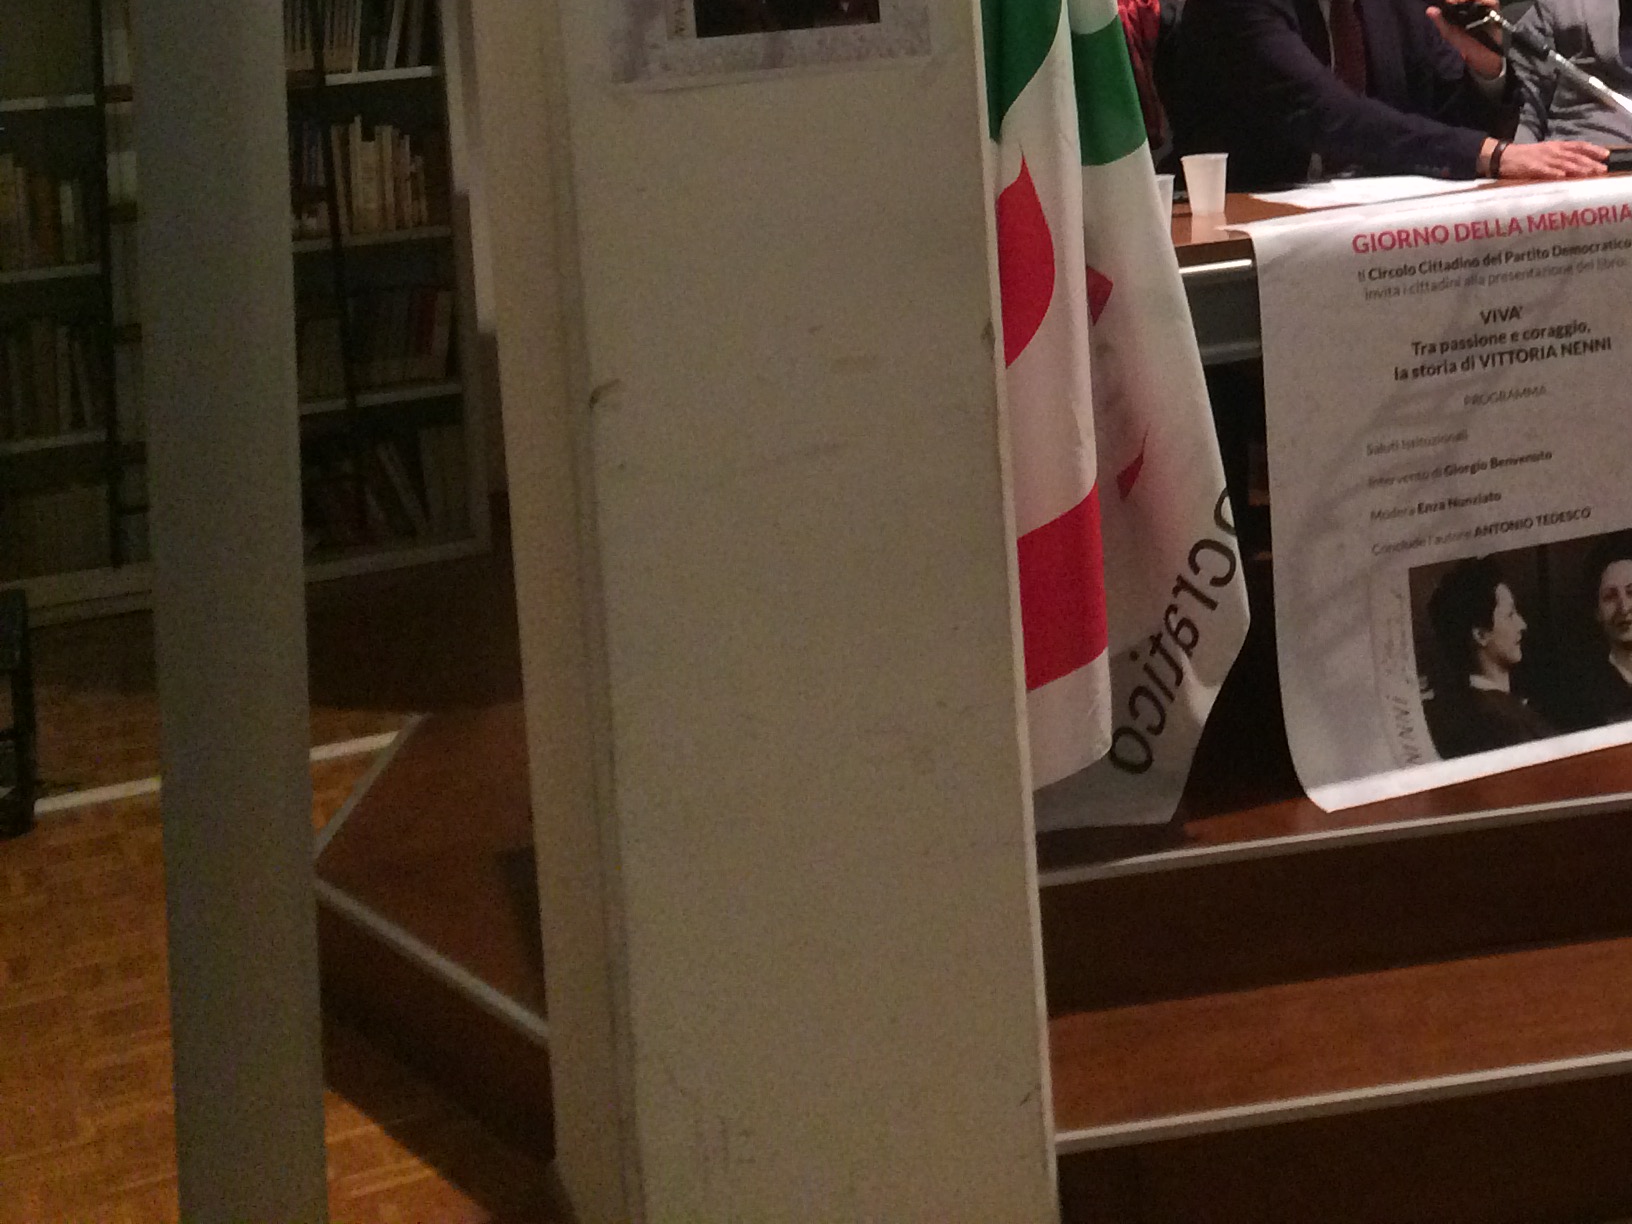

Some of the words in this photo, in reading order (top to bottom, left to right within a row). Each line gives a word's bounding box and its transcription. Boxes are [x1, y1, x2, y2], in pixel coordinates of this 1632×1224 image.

[1352, 225, 1450, 254] GIORNO
[1454, 218, 1523, 243] DELLA
[1367, 262, 1417, 282] Circolo
[1418, 254, 1481, 275] Cittadino
[1482, 250, 1503, 267] del
[1504, 246, 1550, 265] Partito
[1551, 237, 1632, 258] Democratico
[1394, 366, 1408, 382] la
[1411, 358, 1457, 379] storia
[1460, 355, 1476, 373] di
[1479, 344, 1558, 370] VITTORIA
[1560, 336, 1612, 357] NENNI
[1411, 340, 1437, 357] Tra
[1439, 331, 1507, 355] passione
[1510, 332, 1519, 343] e
[1443, 458, 1488, 478] Giorgio
[1417, 500, 1446, 515] Enza
[1474, 516, 1534, 539] ANTONIO
[1536, 506, 1593, 528] TEDESCO
